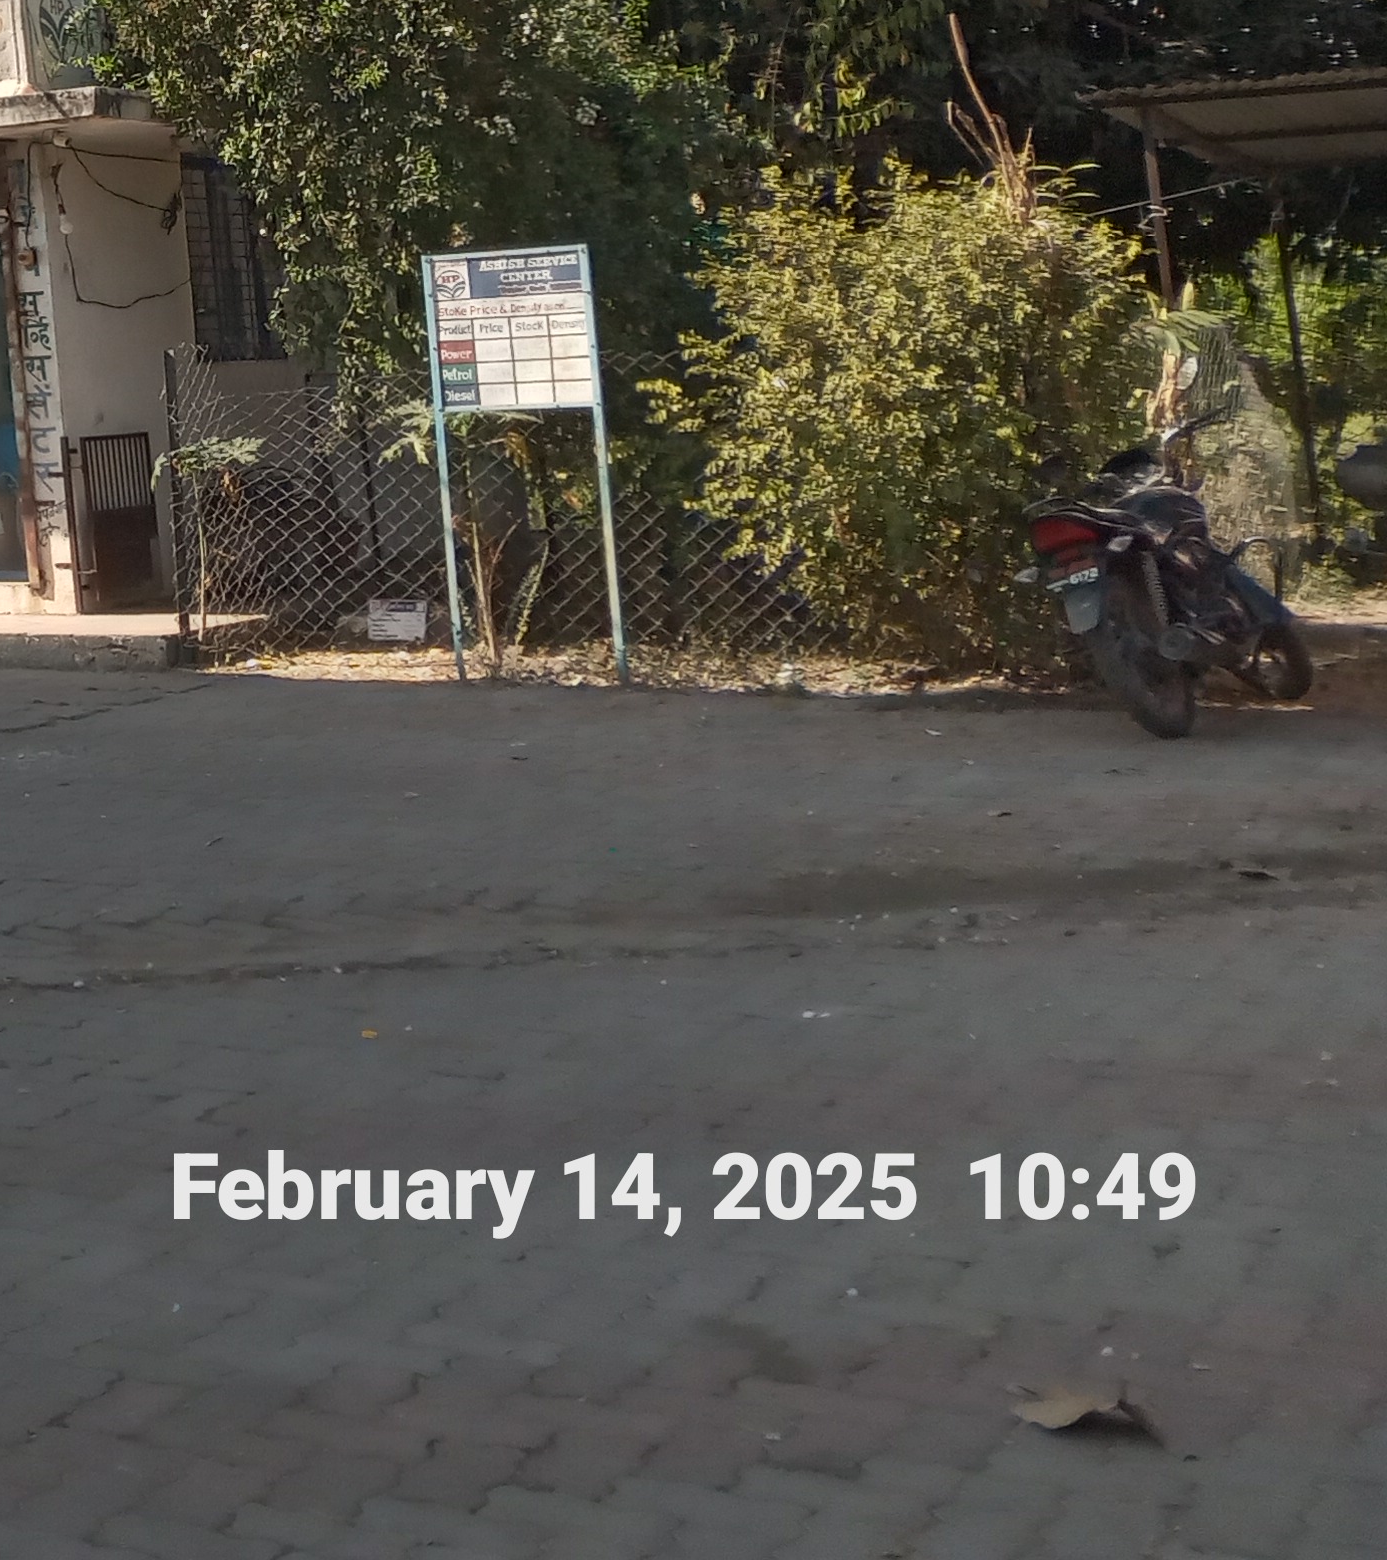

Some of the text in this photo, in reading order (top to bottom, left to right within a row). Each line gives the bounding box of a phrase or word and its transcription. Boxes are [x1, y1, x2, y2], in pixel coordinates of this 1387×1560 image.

[478, 258, 525, 272] ASHISH
[527, 253, 579, 268] SERVICE
[441, 274, 460, 284] HP
[500, 269, 554, 283] CENTER
[442, 368, 473, 381] Petrol
[445, 390, 476, 401] Diesel
